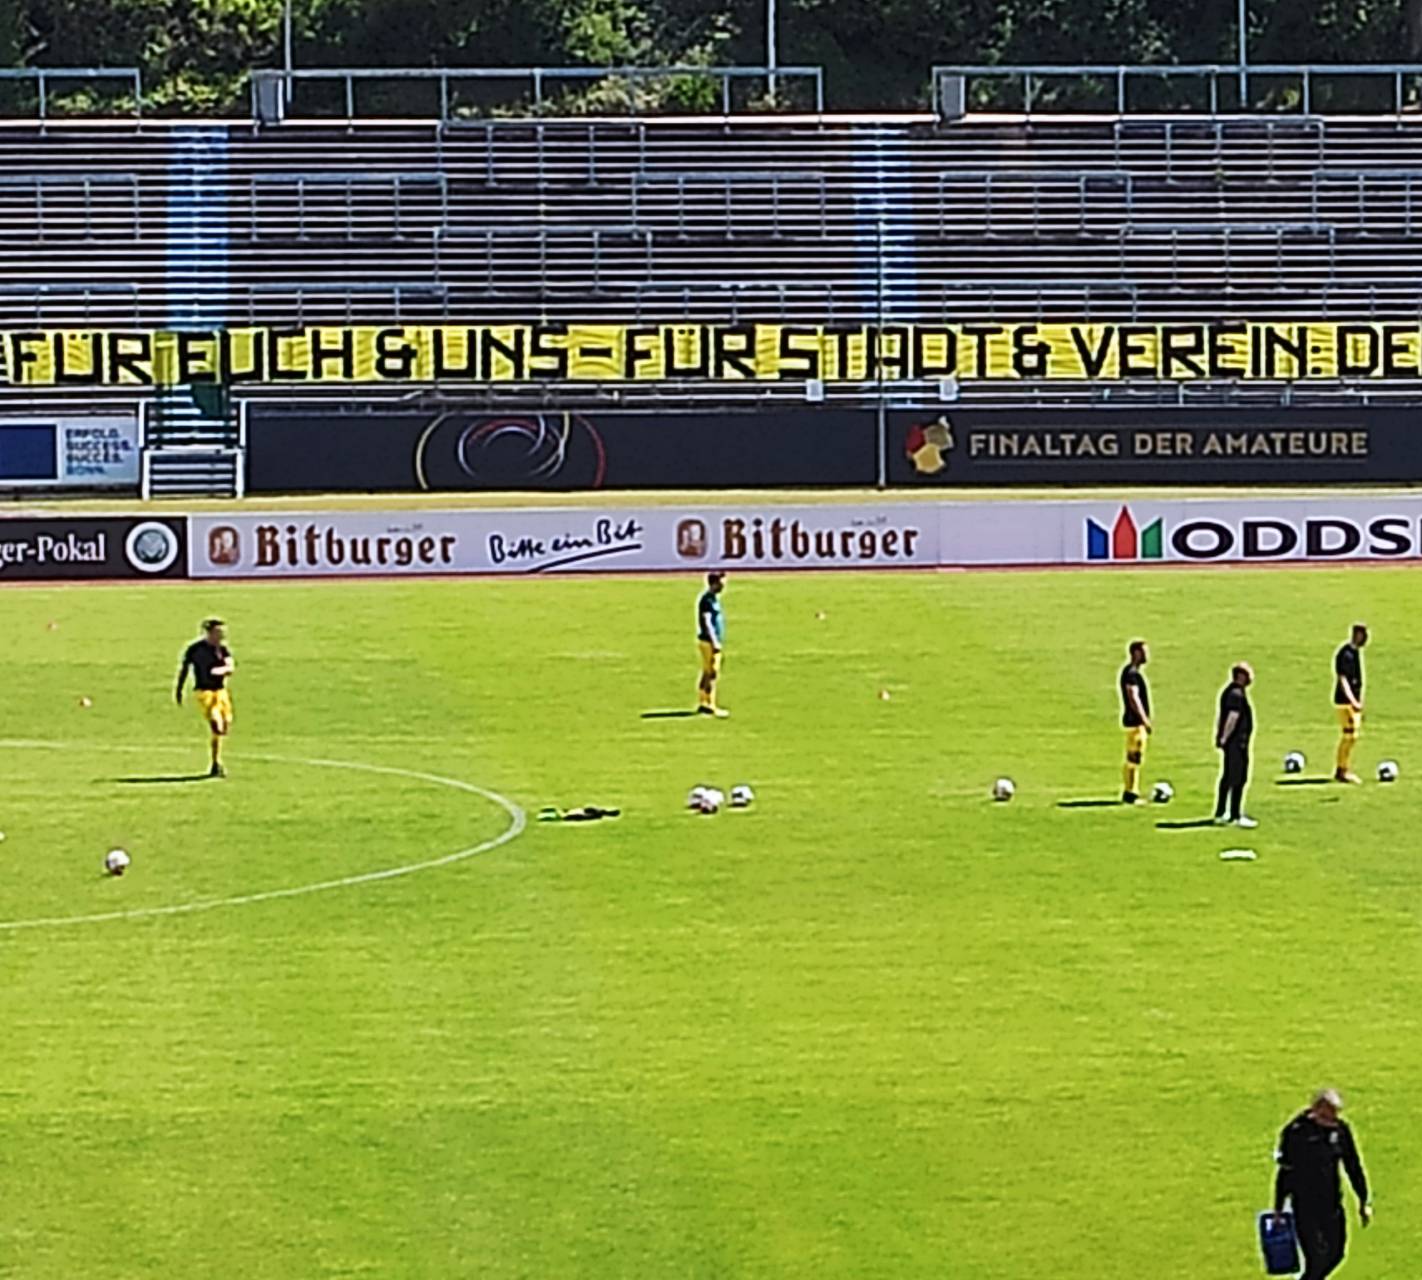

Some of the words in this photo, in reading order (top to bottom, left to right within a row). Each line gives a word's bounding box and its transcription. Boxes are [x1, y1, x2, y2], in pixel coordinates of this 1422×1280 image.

[10, 332, 154, 384] FÜR
[177, 327, 353, 382] EUCH
[376, 328, 418, 378] &
[433, 325, 569, 379] UNS
[779, 325, 1004, 379] STADT
[969, 432, 1119, 457] FINALTAG
[1134, 431, 1194, 456] DER
[1202, 431, 1368, 455] AMATEURE
[255, 524, 456, 567] Bitburger
[489, 534, 546, 564] Bitte
[551, 533, 593, 550] ein
[596, 518, 644, 546] Bit
[720, 516, 919, 560] Bitburger
